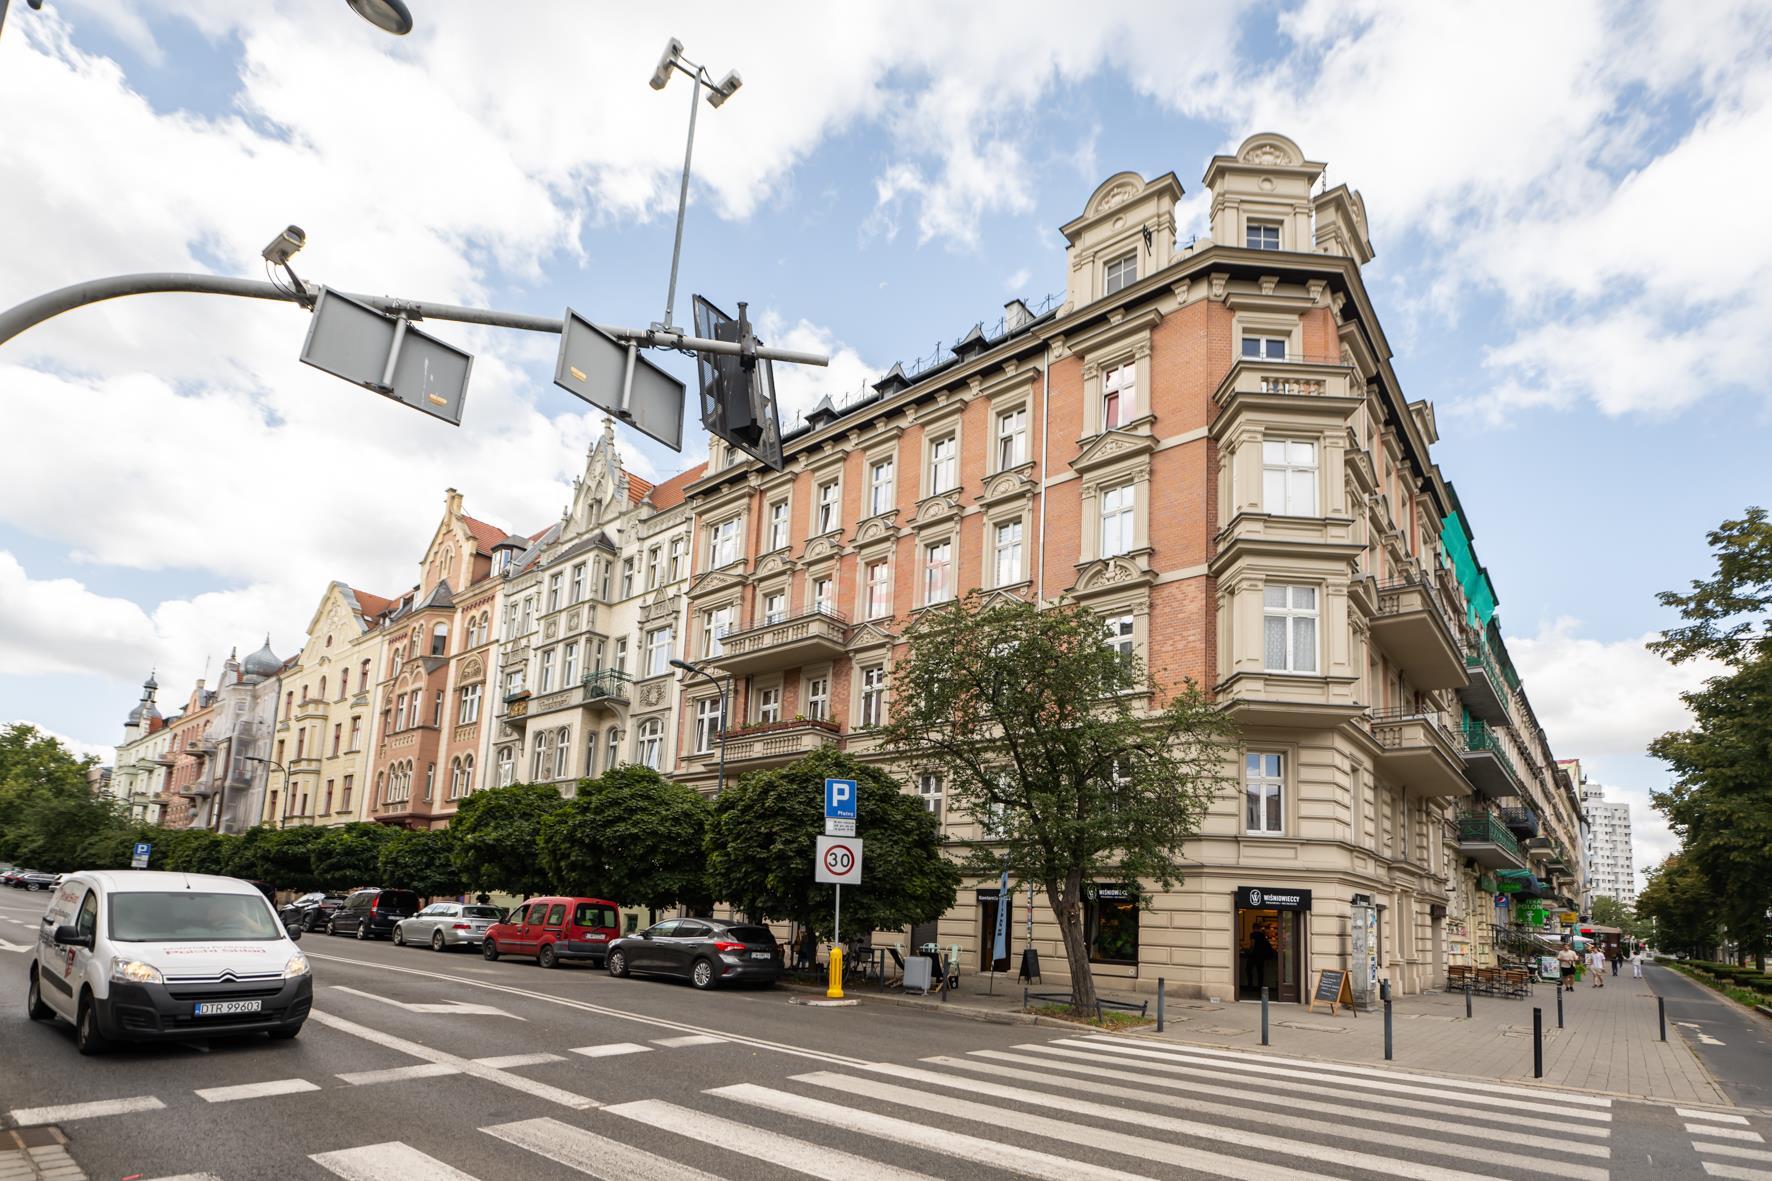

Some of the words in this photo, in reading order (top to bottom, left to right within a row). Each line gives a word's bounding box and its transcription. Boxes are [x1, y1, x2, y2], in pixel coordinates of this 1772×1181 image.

[832, 783, 850, 807] P
[137, 844, 148, 854] P
[828, 852, 850, 868] 30
[1263, 894, 1300, 903] WIŚNIOWIECCY
[201, 1003, 223, 1014] DTR
[227, 1001, 260, 1012] 99603
